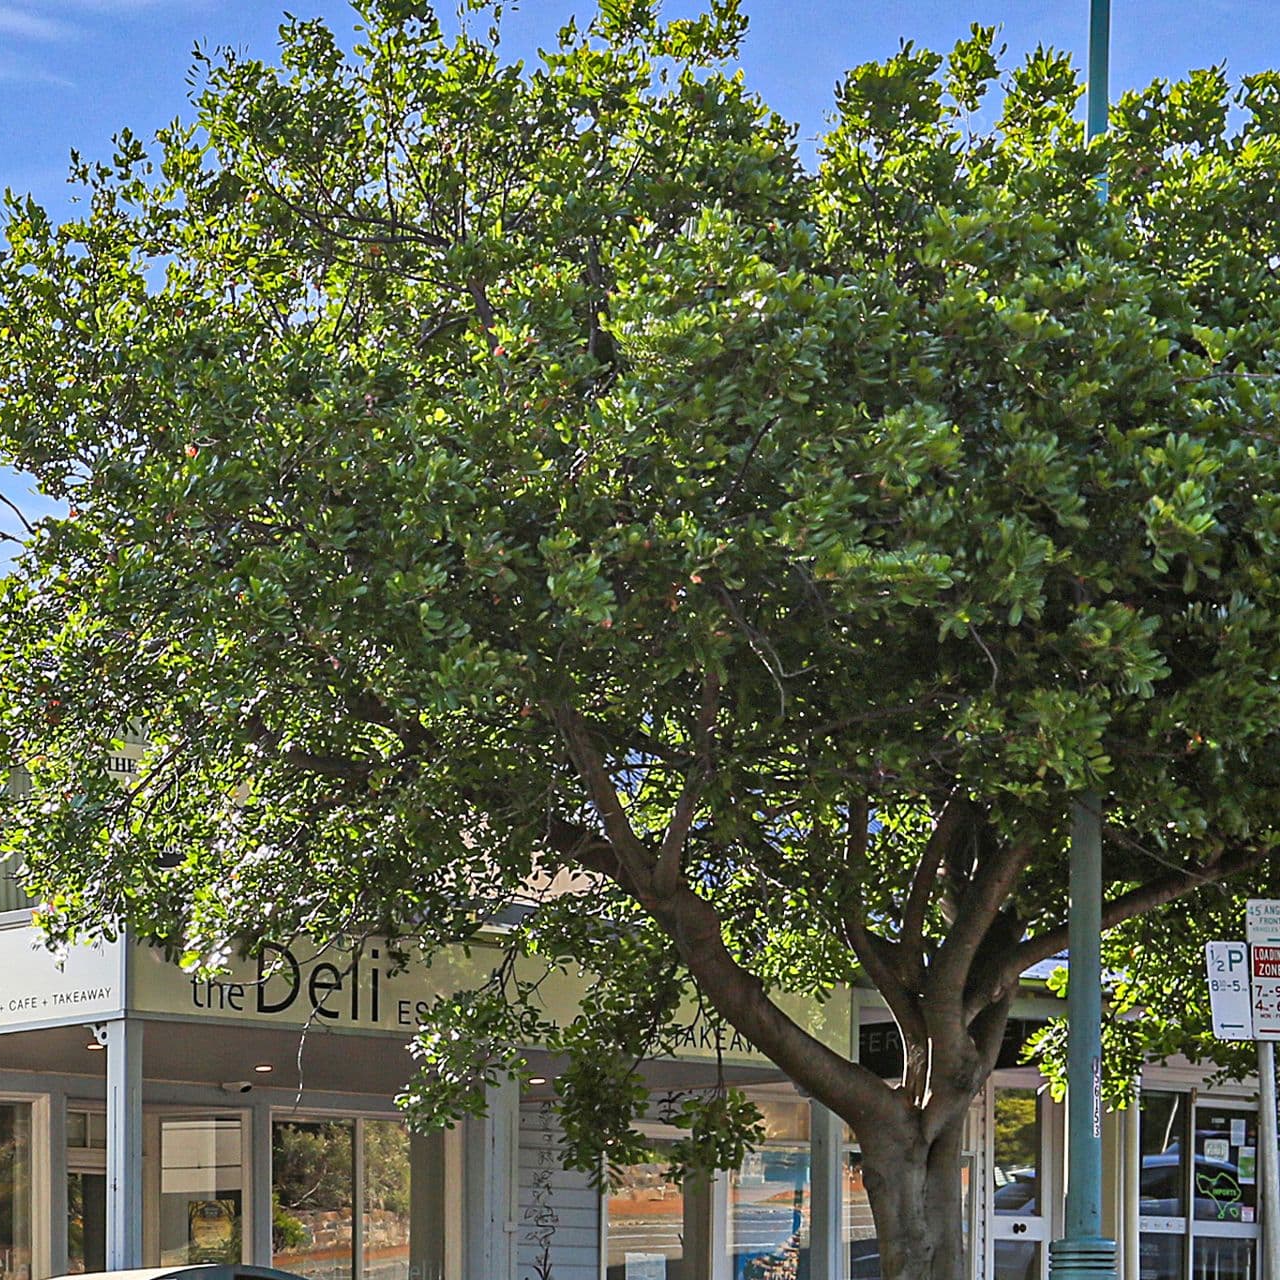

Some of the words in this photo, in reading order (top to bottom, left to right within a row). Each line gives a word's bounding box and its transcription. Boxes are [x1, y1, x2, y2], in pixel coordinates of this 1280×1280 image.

[1228, 950, 1243, 972] P
[190, 975, 245, 1011] the
[256, 941, 380, 1023] Deli
[9, 996, 38, 1012] CAFE
[53, 987, 113, 1006] TAKEAWAY
